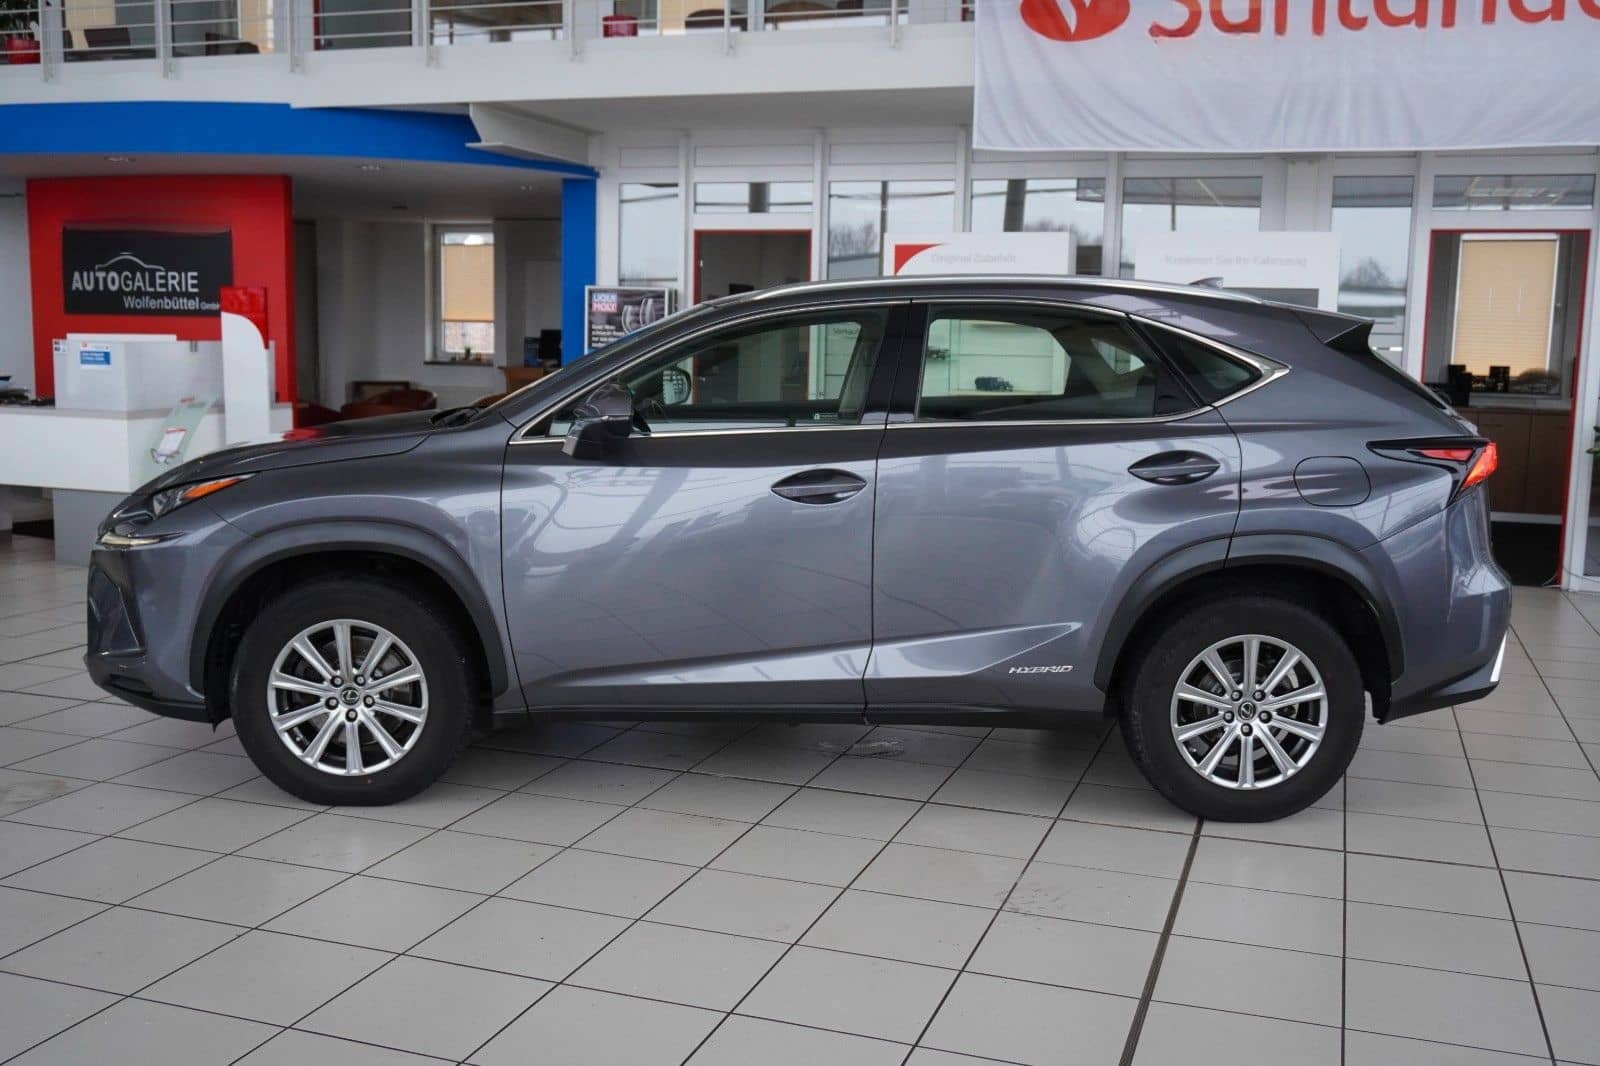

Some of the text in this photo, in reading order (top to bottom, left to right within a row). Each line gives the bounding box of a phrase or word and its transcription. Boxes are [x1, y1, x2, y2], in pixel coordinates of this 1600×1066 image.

[1148, 0, 1600, 38] Sanan
[72, 271, 200, 292] AUTOGALERIE
[123, 296, 199, 310] Wolfenbüttel
[1008, 665, 1074, 674] HYBRID
